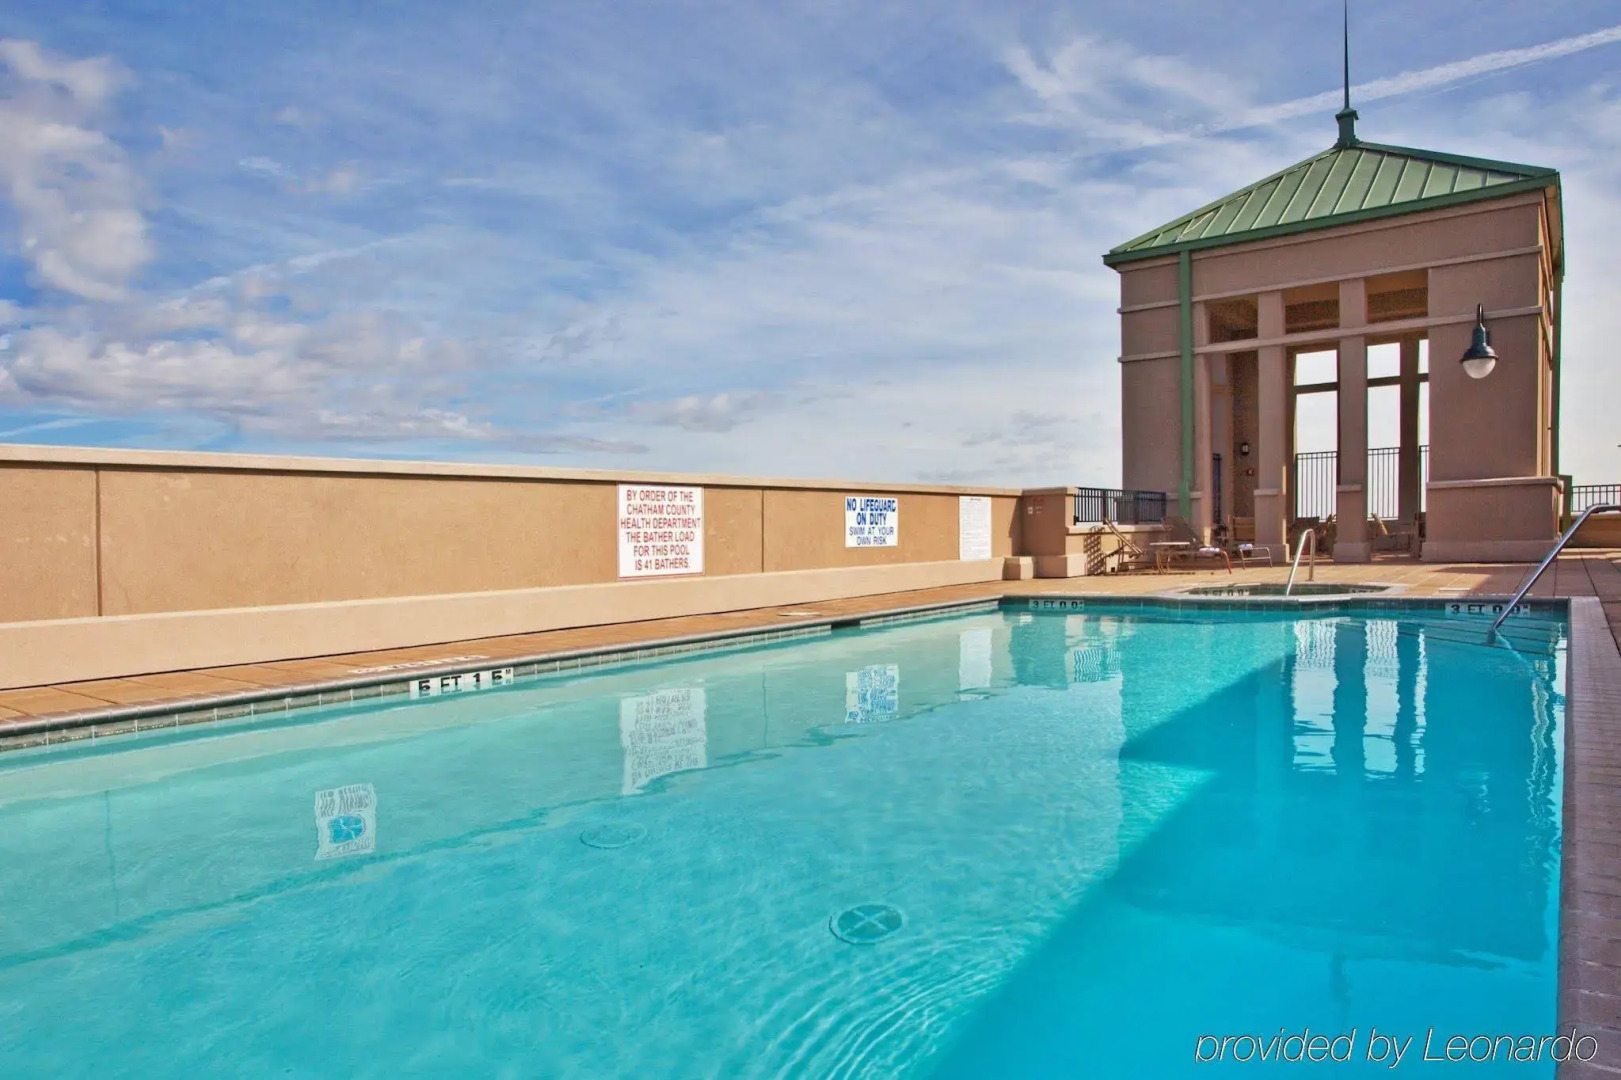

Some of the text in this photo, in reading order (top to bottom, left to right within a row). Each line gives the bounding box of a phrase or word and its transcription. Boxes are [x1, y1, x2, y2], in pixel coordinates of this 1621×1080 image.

[626, 489, 694, 502] BY ORDER OF THE
[626, 504, 695, 516] CHATHAM COUNTY
[846, 498, 857, 511] NO
[620, 517, 701, 529] HEALTH DEPARTMENT
[856, 512, 887, 526] ON DUTY
[626, 531, 695, 543] THE BATHER LOAD
[849, 526, 894, 536] SWIM AT YOUR
[856, 536, 887, 546] OWN RISK
[633, 544, 690, 557] FOR THIS POOL
[635, 559, 642, 571] IS
[644, 559, 653, 571] 41
